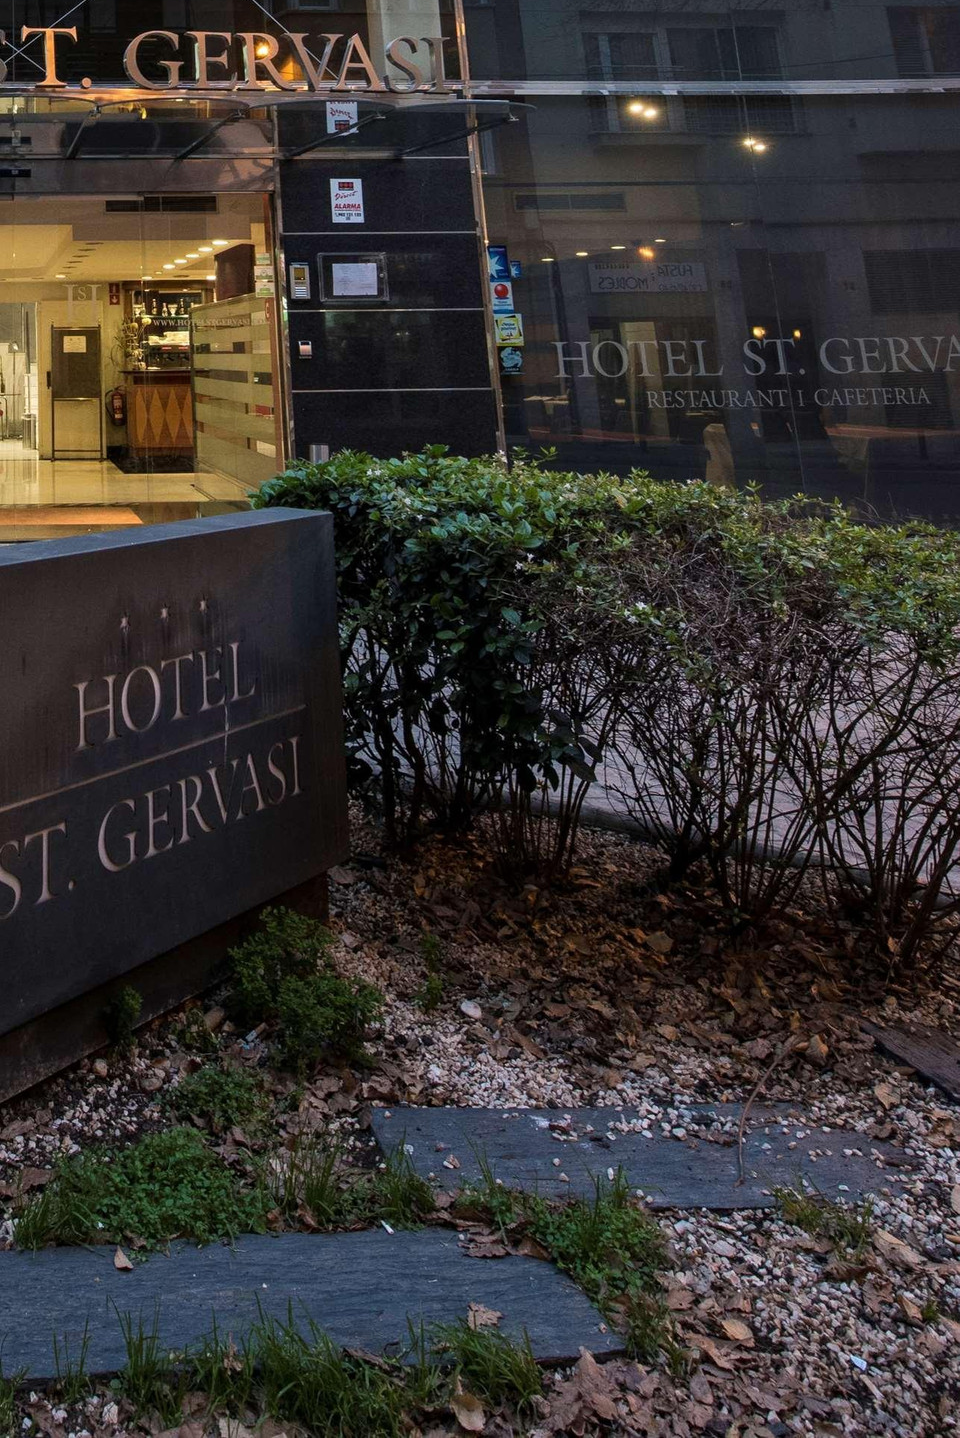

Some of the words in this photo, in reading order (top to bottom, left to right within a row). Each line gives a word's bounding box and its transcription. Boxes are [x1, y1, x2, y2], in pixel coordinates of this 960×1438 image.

[123, 30, 451, 95] GERVASI
[550, 340, 723, 378] HOTEL
[742, 339, 806, 376] ST.
[647, 388, 788, 409] RESTAURANT
[814, 387, 931, 406] CAFETERIA
[72, 641, 256, 751] HOTEL
[97, 734, 303, 872] GERVASI
